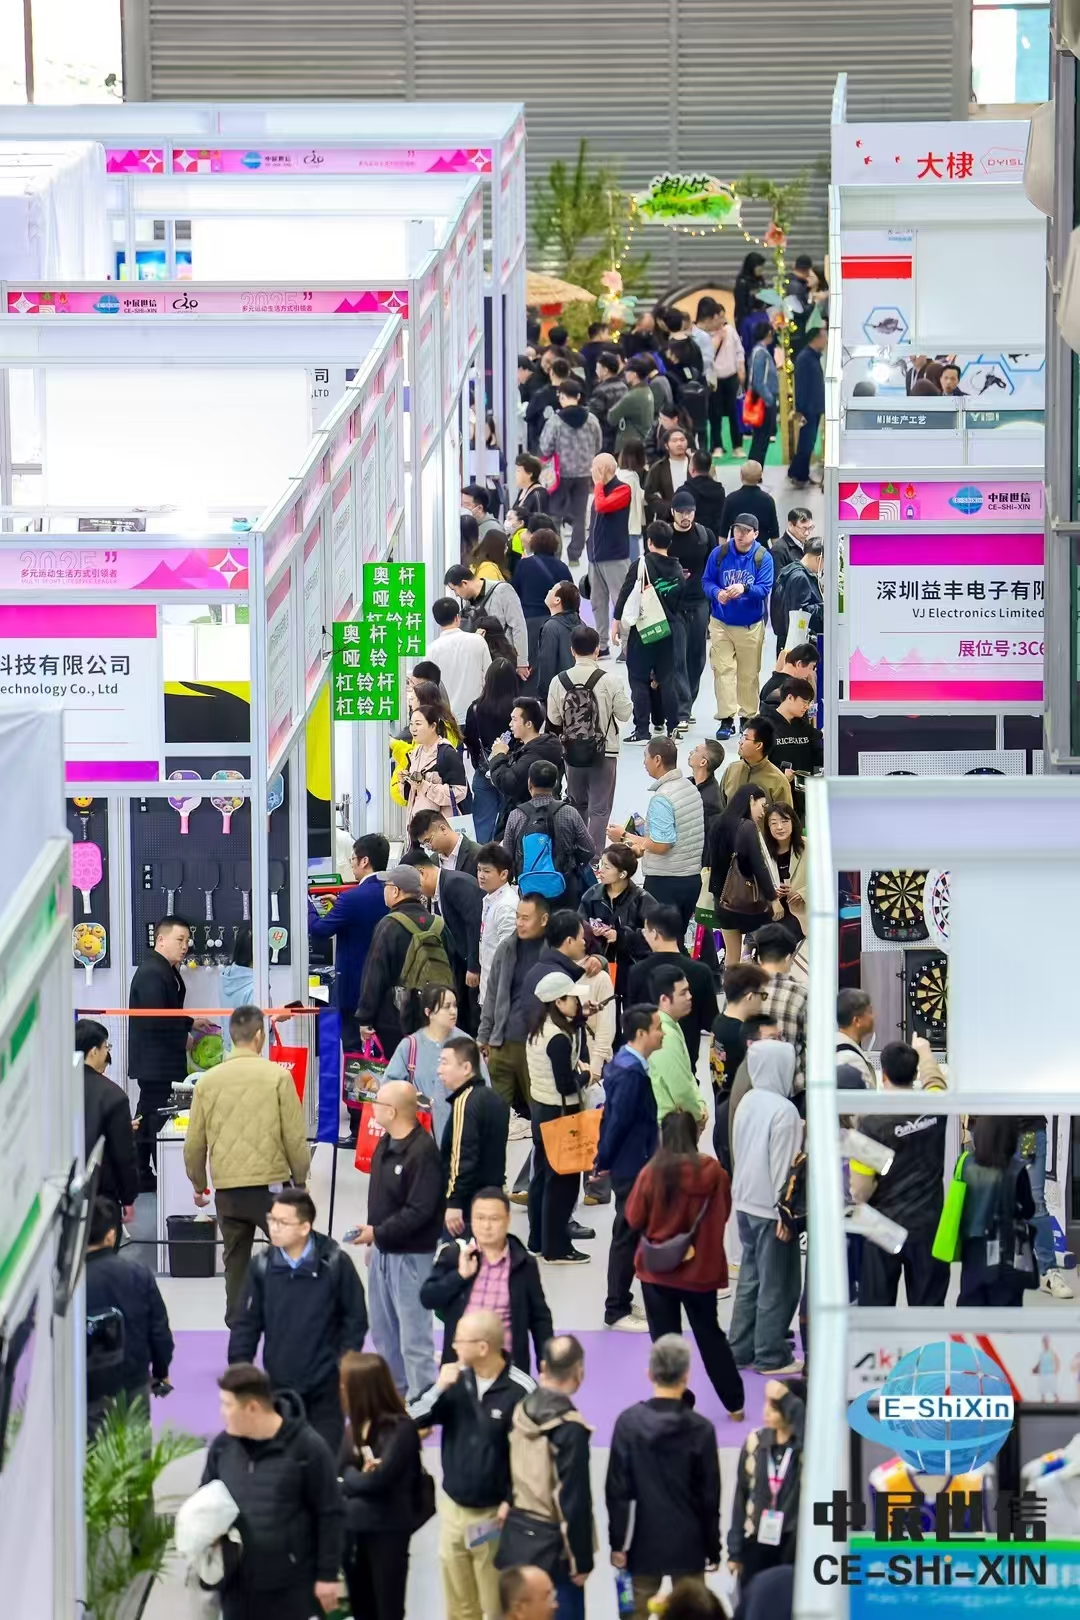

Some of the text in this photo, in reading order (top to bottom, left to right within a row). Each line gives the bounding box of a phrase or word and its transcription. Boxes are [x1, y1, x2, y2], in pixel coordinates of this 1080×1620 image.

[988, 492, 1030, 502] 中展世信
[21, 569, 118, 578] 多元运动生活方式引领者
[912, 608, 1044, 617] VJ Electronics Limited
[336, 673, 395, 691] 杠铃杆
[70, 684, 95, 697] Co.,
[98, 683, 118, 694] Ltd
[336, 697, 395, 715] 杠铃片
